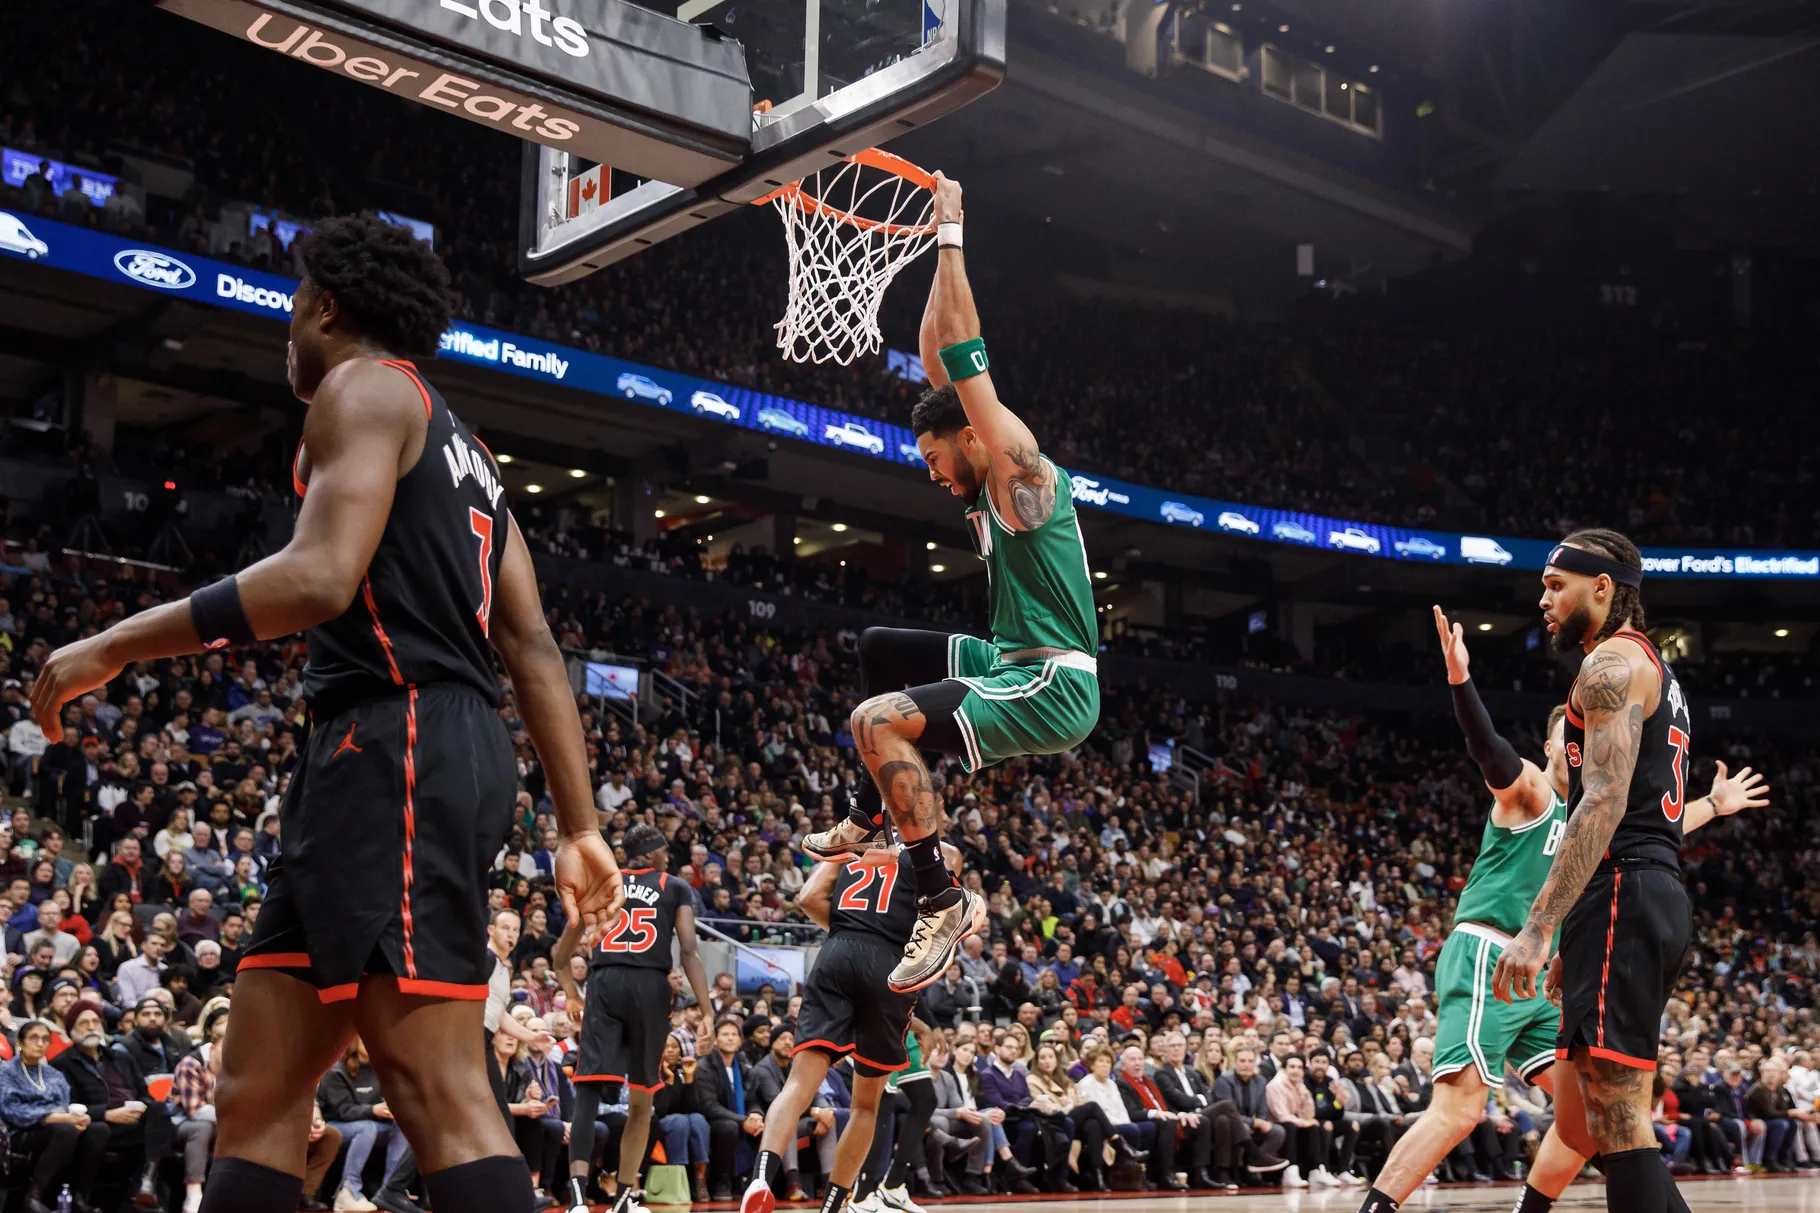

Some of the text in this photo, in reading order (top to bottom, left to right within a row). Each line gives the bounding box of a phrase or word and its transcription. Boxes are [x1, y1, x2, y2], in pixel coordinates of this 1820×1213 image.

[246, 13, 580, 140] Uber Eats
[127, 253, 569, 379] Ford Discov rified Family
[1070, 475, 1109, 506] Ford
[1640, 555, 1819, 574] over Ford's Electrified
[748, 599, 776, 619] 109
[837, 860, 899, 913] 21
[600, 907, 658, 953] 25
